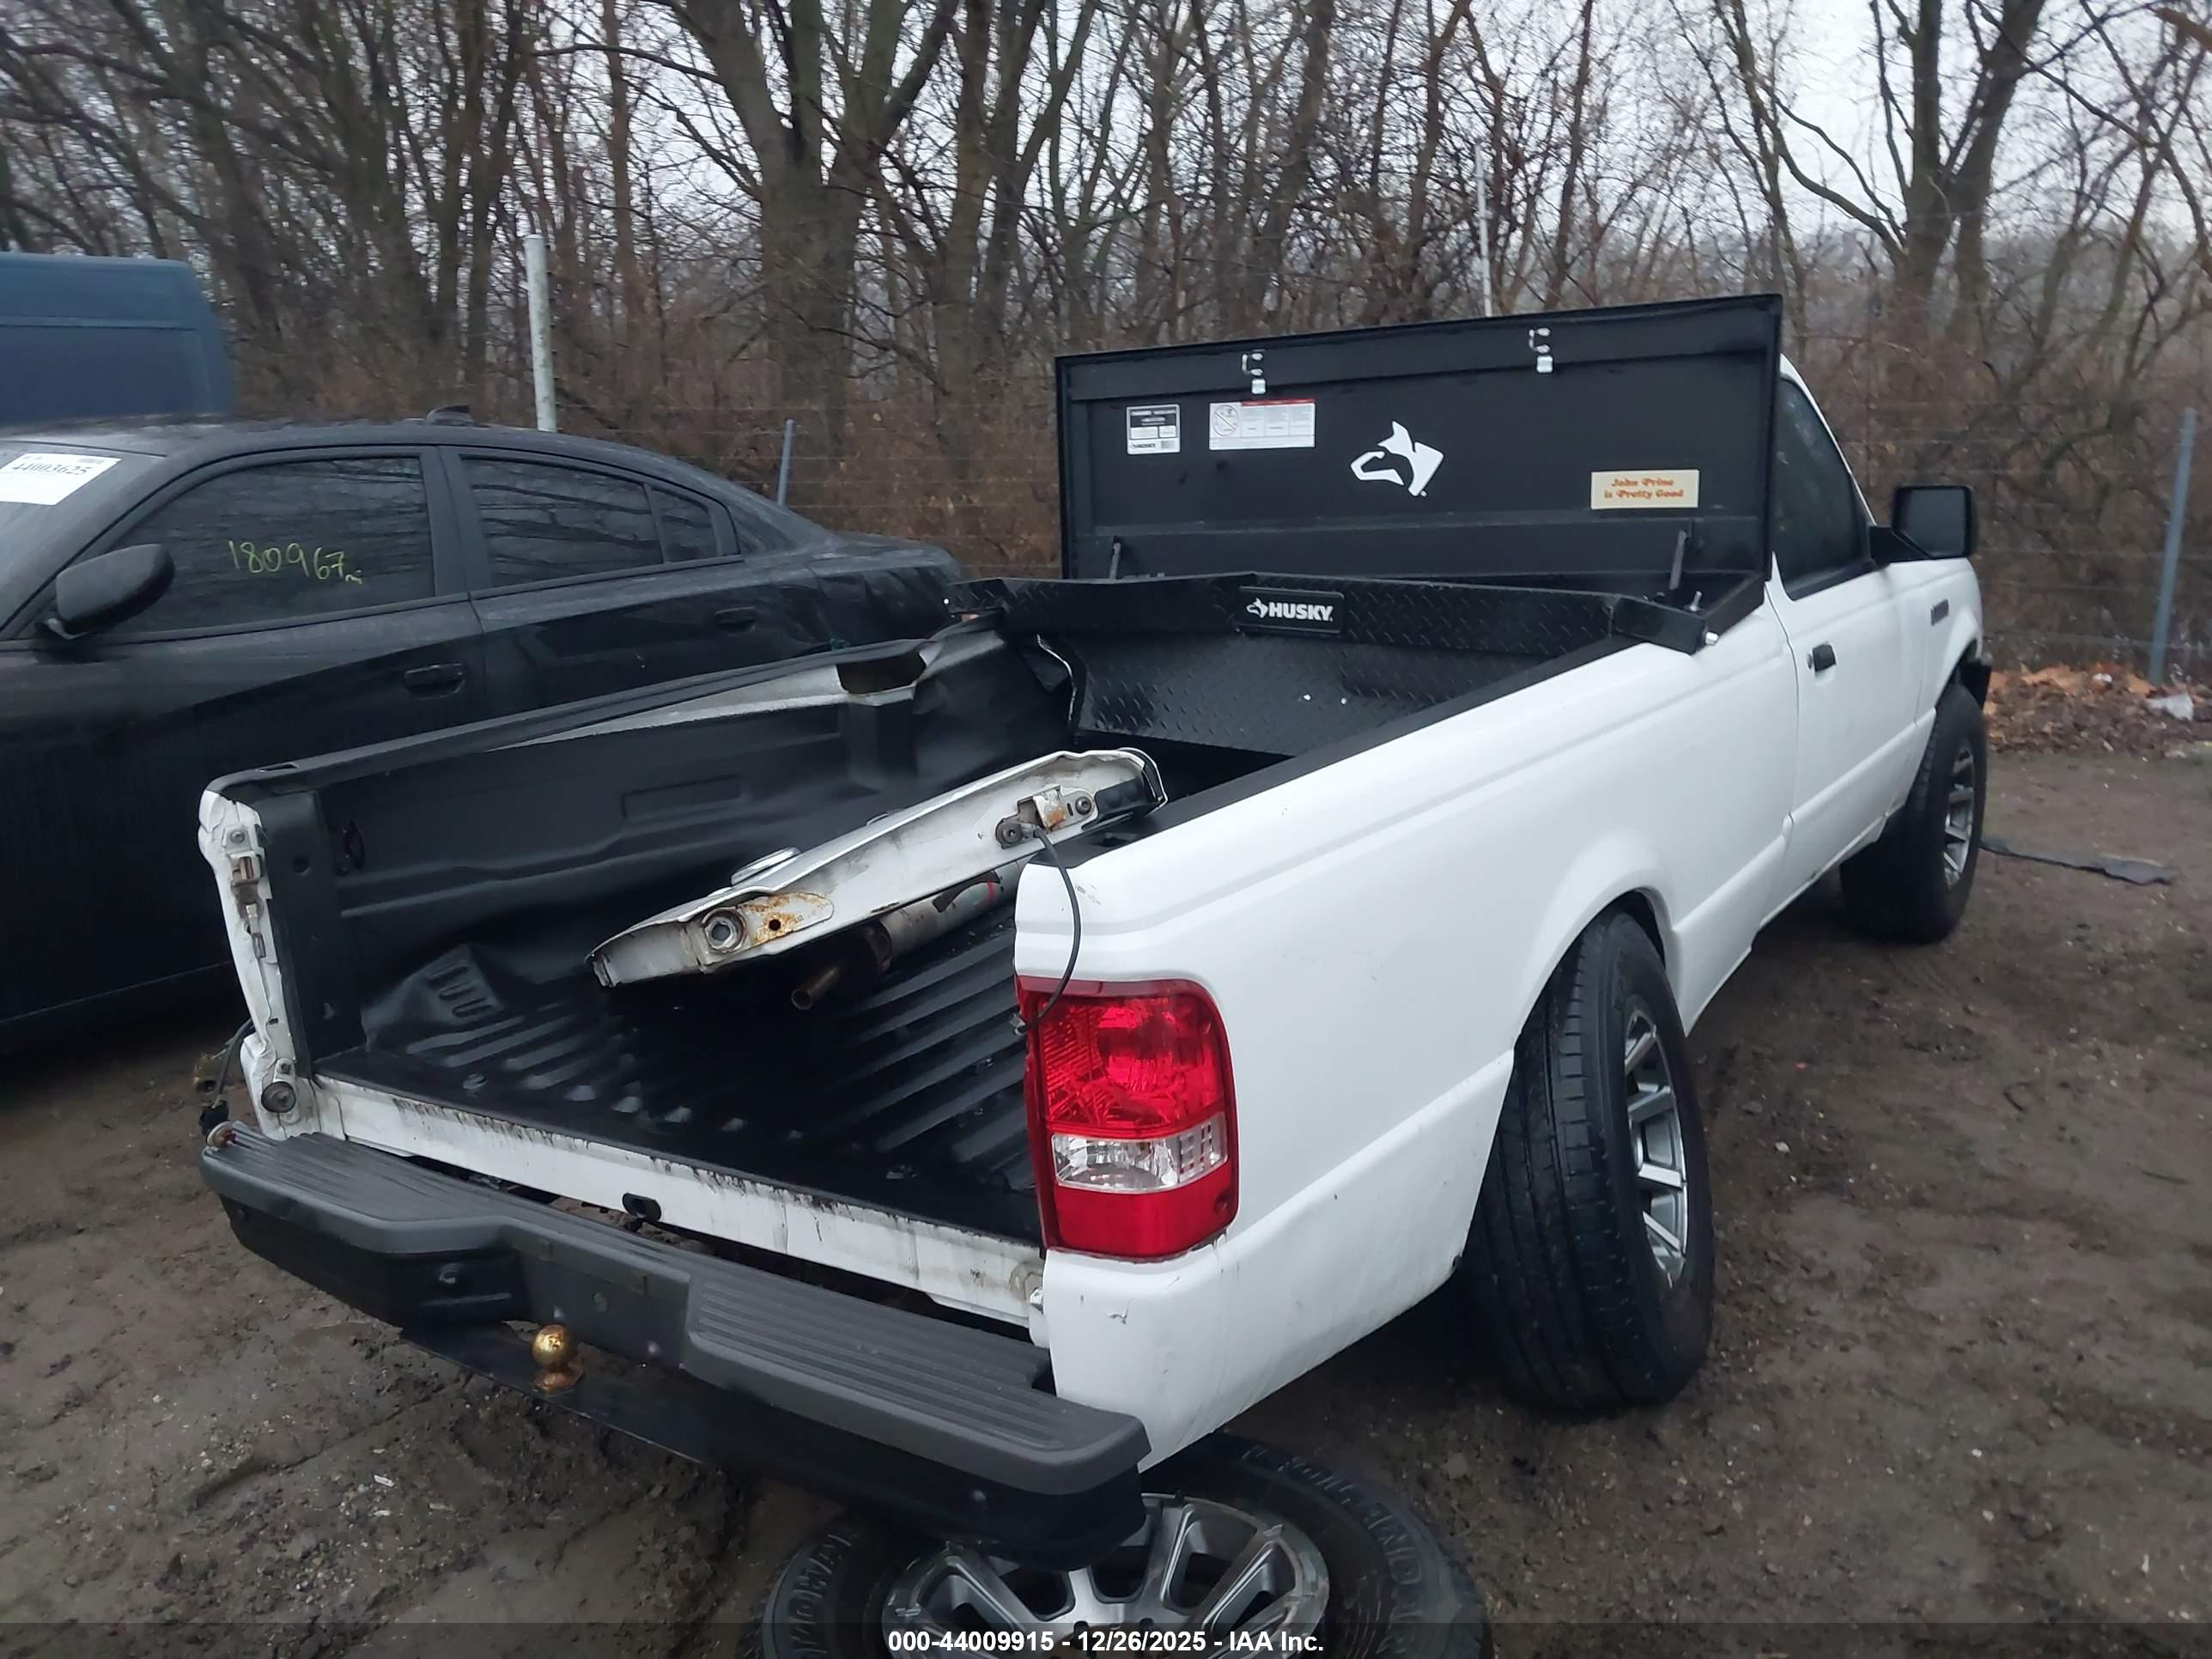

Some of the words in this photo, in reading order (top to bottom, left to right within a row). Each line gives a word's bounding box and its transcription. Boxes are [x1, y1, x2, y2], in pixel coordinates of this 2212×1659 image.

[10, 462, 93, 476] 44003625
[1611, 478, 1638, 487] John
[1616, 489, 1652, 500] Pretty
[228, 540, 344, 580] 180967
[1269, 602, 1333, 621] HUSKY
